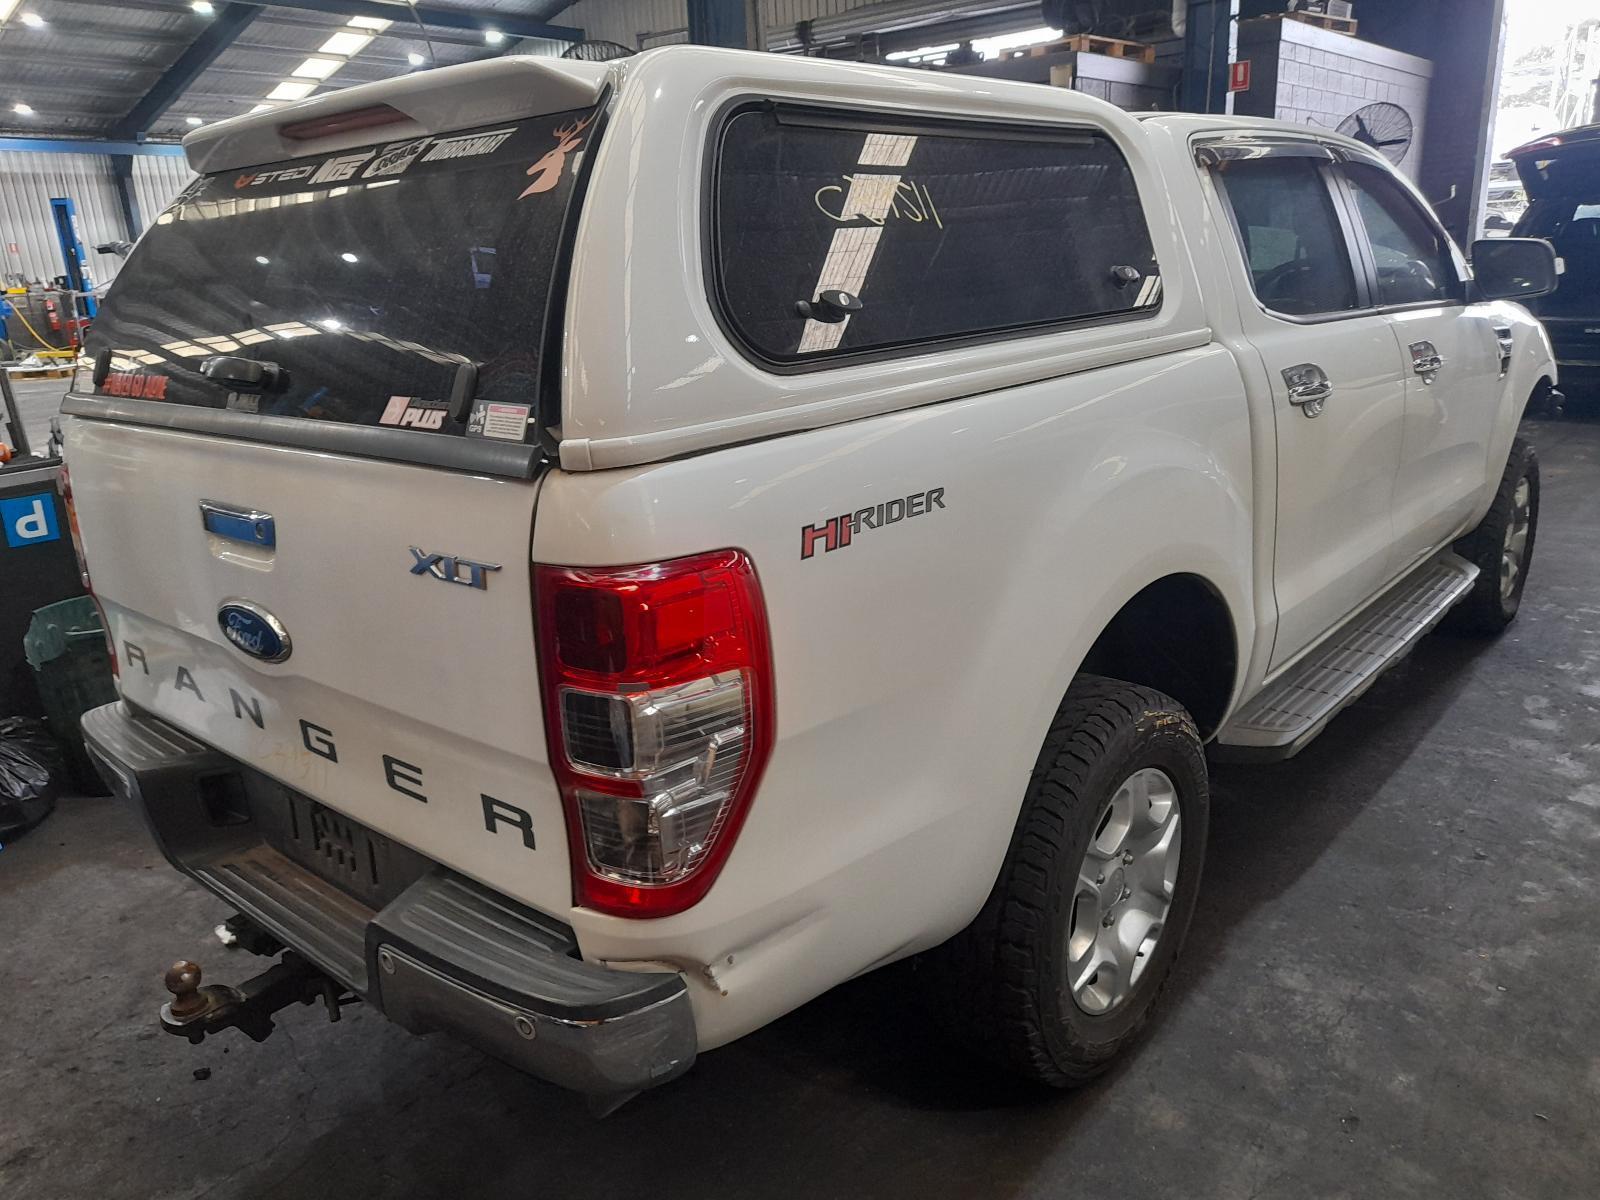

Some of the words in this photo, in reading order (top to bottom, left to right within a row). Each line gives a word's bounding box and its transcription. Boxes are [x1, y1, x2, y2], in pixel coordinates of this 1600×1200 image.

[250, 165, 317, 186] STEDI
[400, 407, 448, 430] PLUS
[408, 545, 503, 591] XLT
[226, 611, 265, 652] Ford
[122, 640, 537, 851] RANGER
